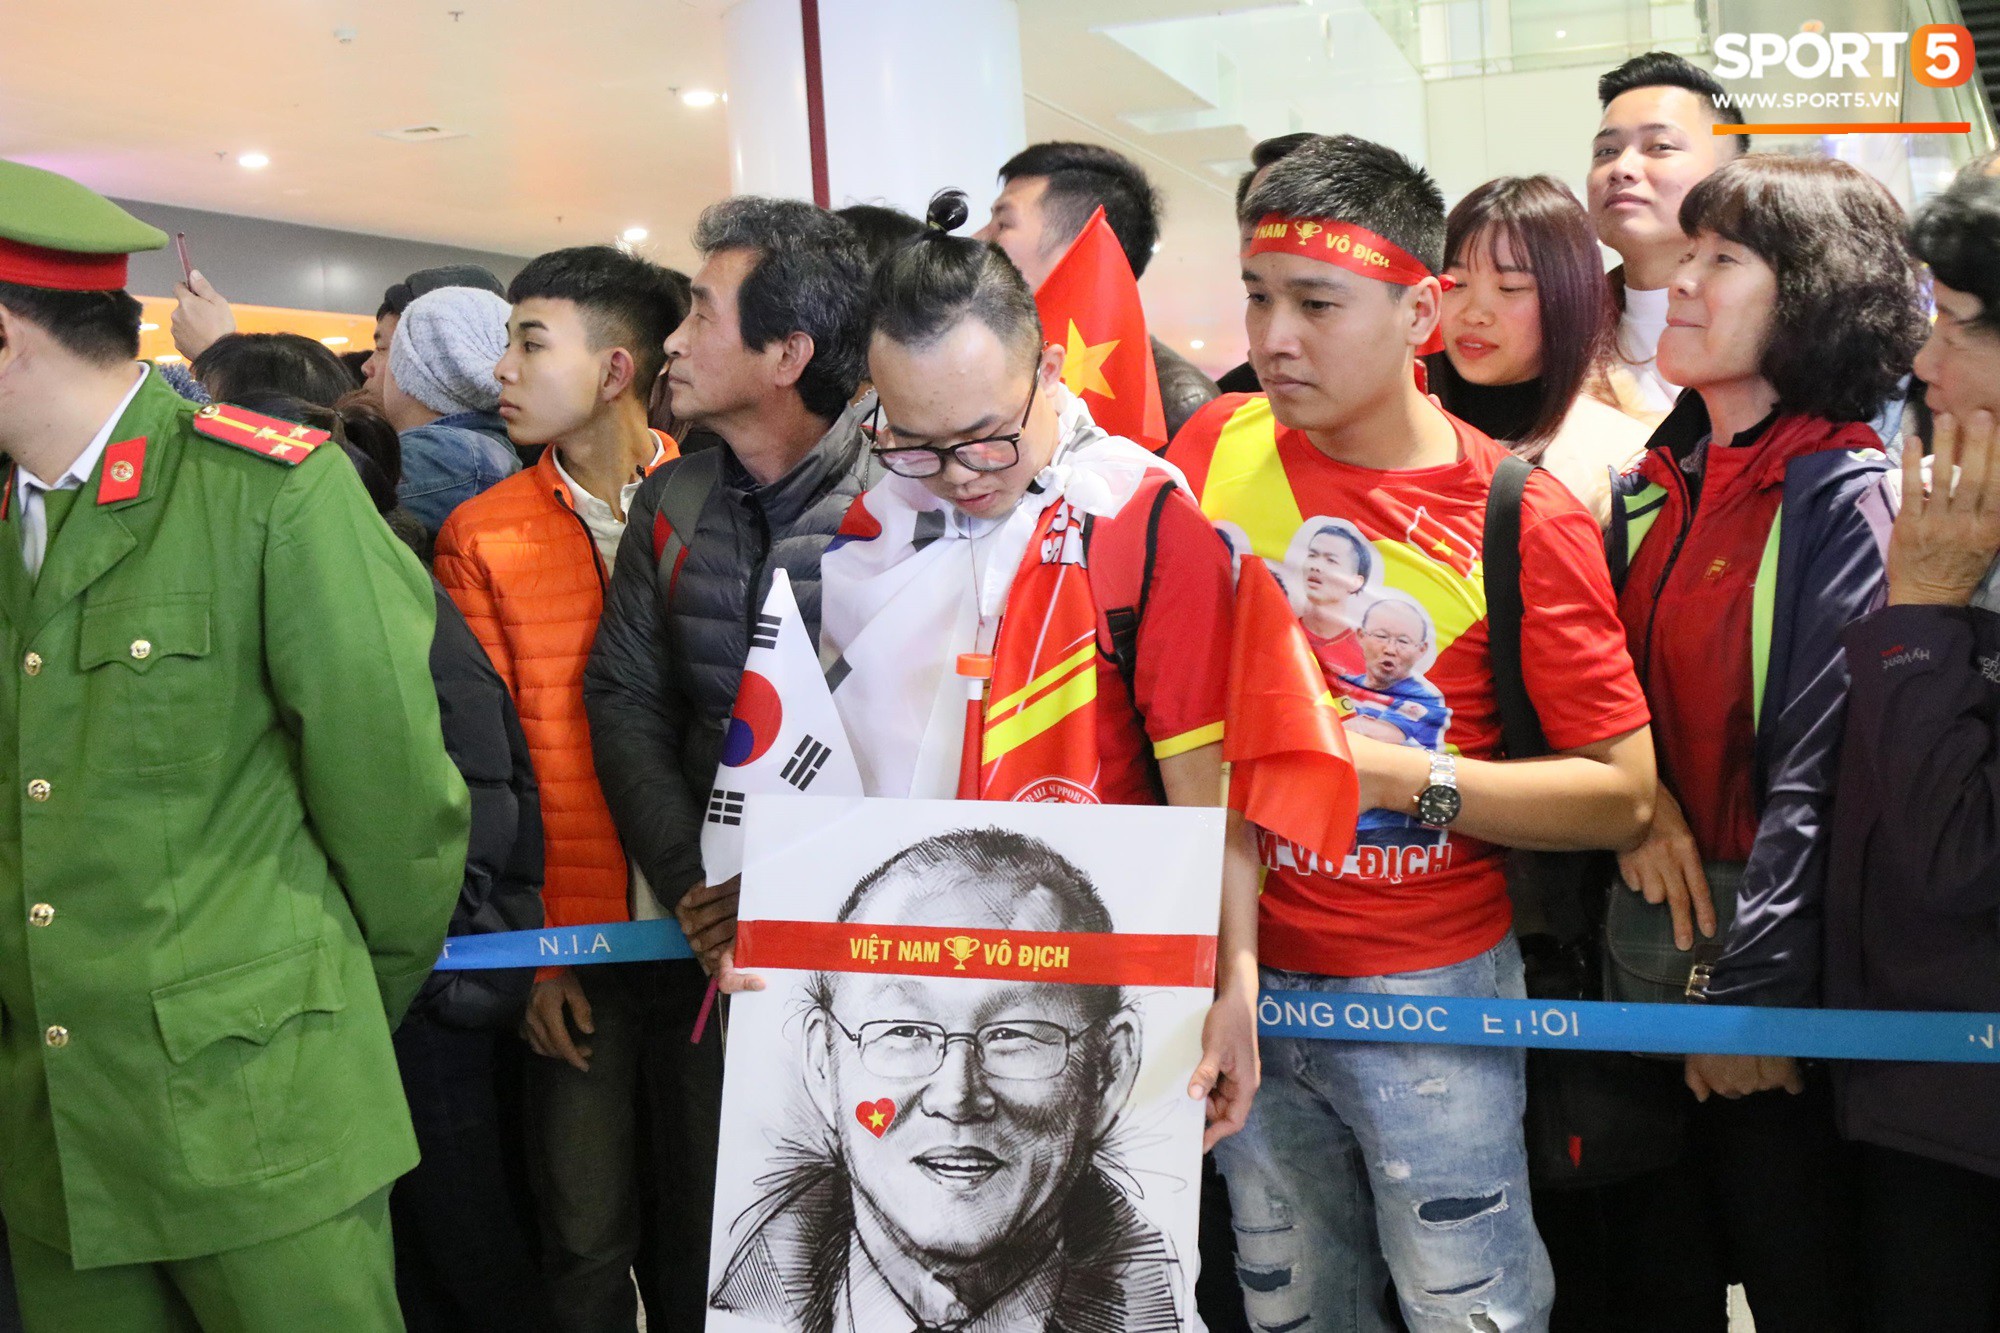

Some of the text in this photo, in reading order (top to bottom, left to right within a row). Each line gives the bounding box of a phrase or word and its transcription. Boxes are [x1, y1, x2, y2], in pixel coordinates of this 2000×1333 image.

[1325, 233, 1350, 253] VÔ
[1356, 844, 1453, 884] ĐỊCH
[539, 932, 612, 956] N.I.A
[849, 933, 1070, 972] VIỆT NAM VÔ ĐỊCH
